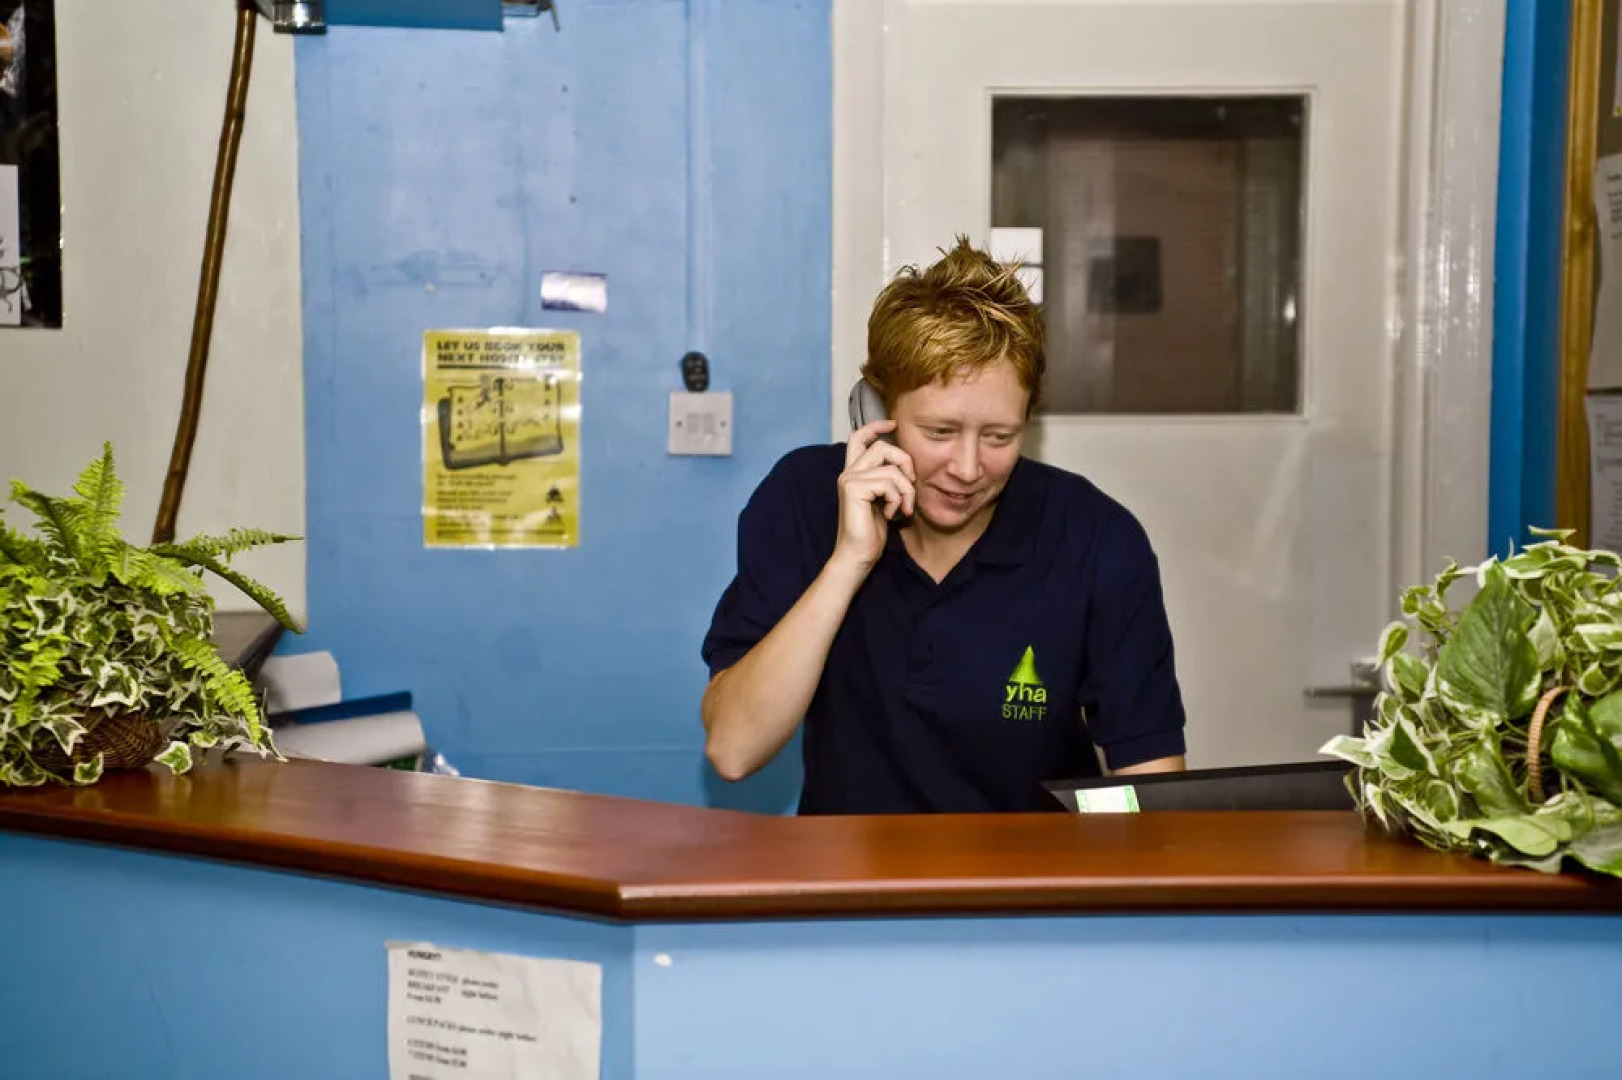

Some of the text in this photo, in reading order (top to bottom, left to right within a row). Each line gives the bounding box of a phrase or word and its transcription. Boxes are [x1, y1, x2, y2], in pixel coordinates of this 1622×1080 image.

[437, 341, 460, 351] LET
[464, 341, 480, 351] US
[437, 353, 474, 363] NEXT
[1006, 683, 1047, 703] yha
[1001, 704, 1048, 720] STAFF
